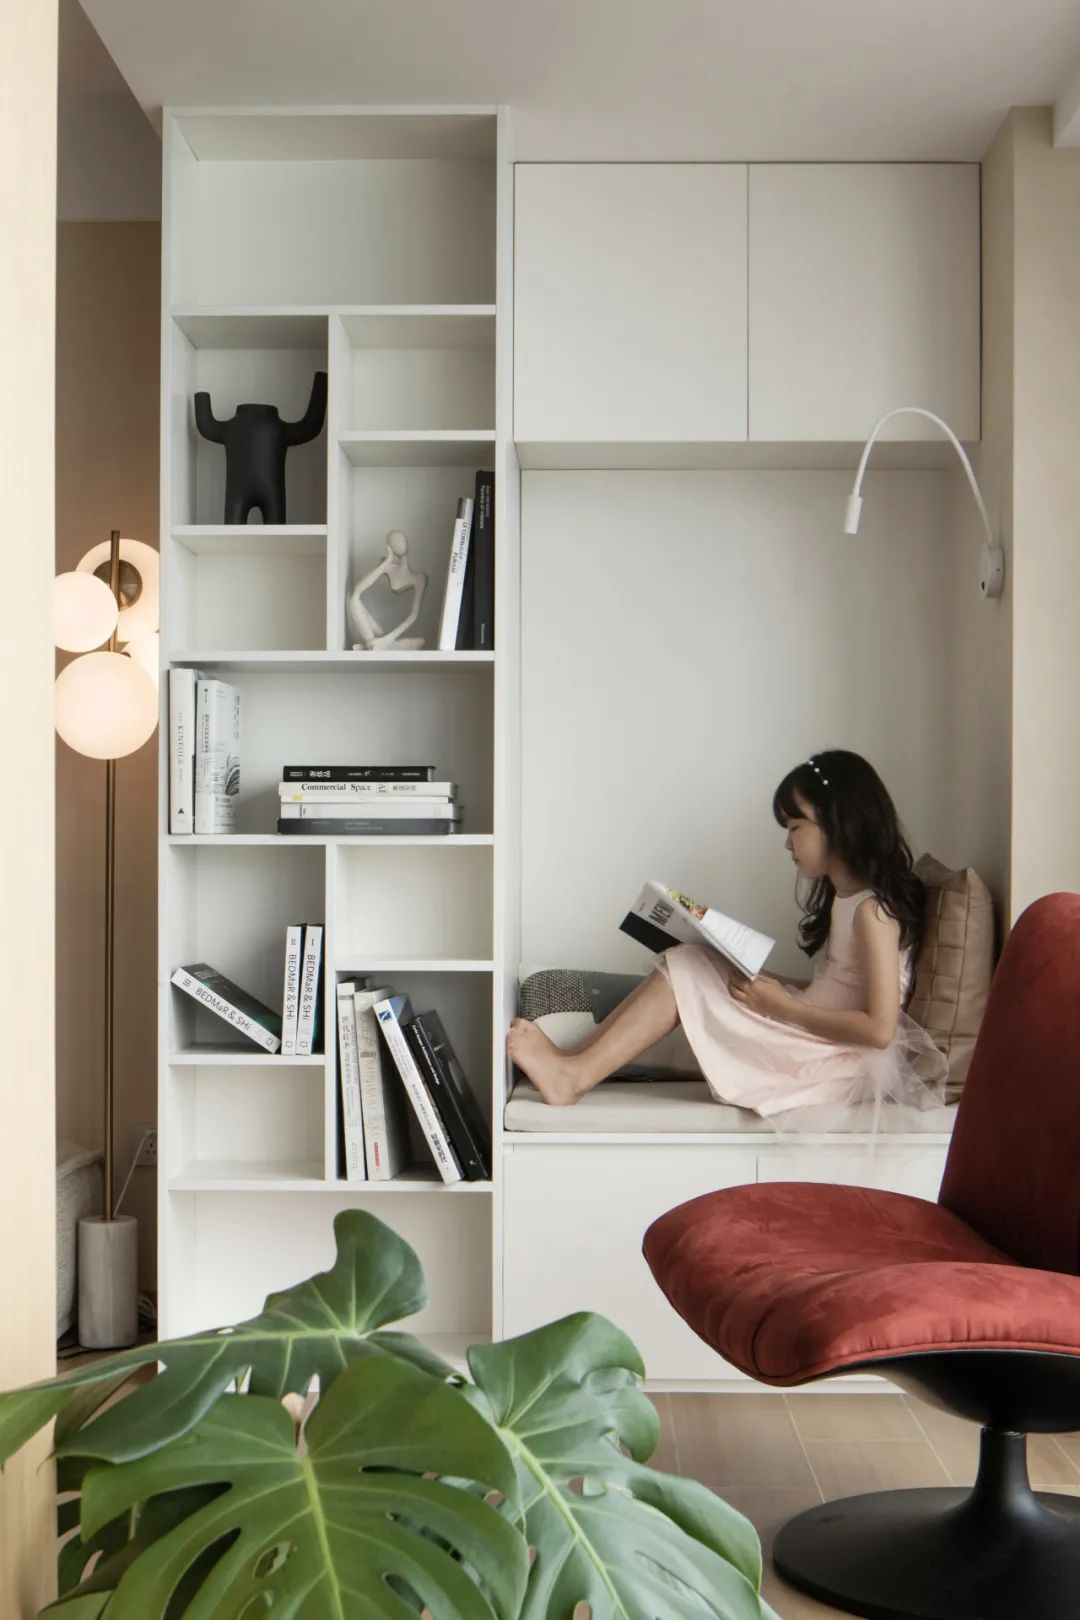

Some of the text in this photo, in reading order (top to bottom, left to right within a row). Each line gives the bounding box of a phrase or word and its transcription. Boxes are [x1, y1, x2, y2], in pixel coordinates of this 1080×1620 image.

[301, 783, 372, 793] Commercial Space
[287, 993, 297, 1003] &
[304, 994, 313, 1003] &
[227, 1011, 236, 1021] &
